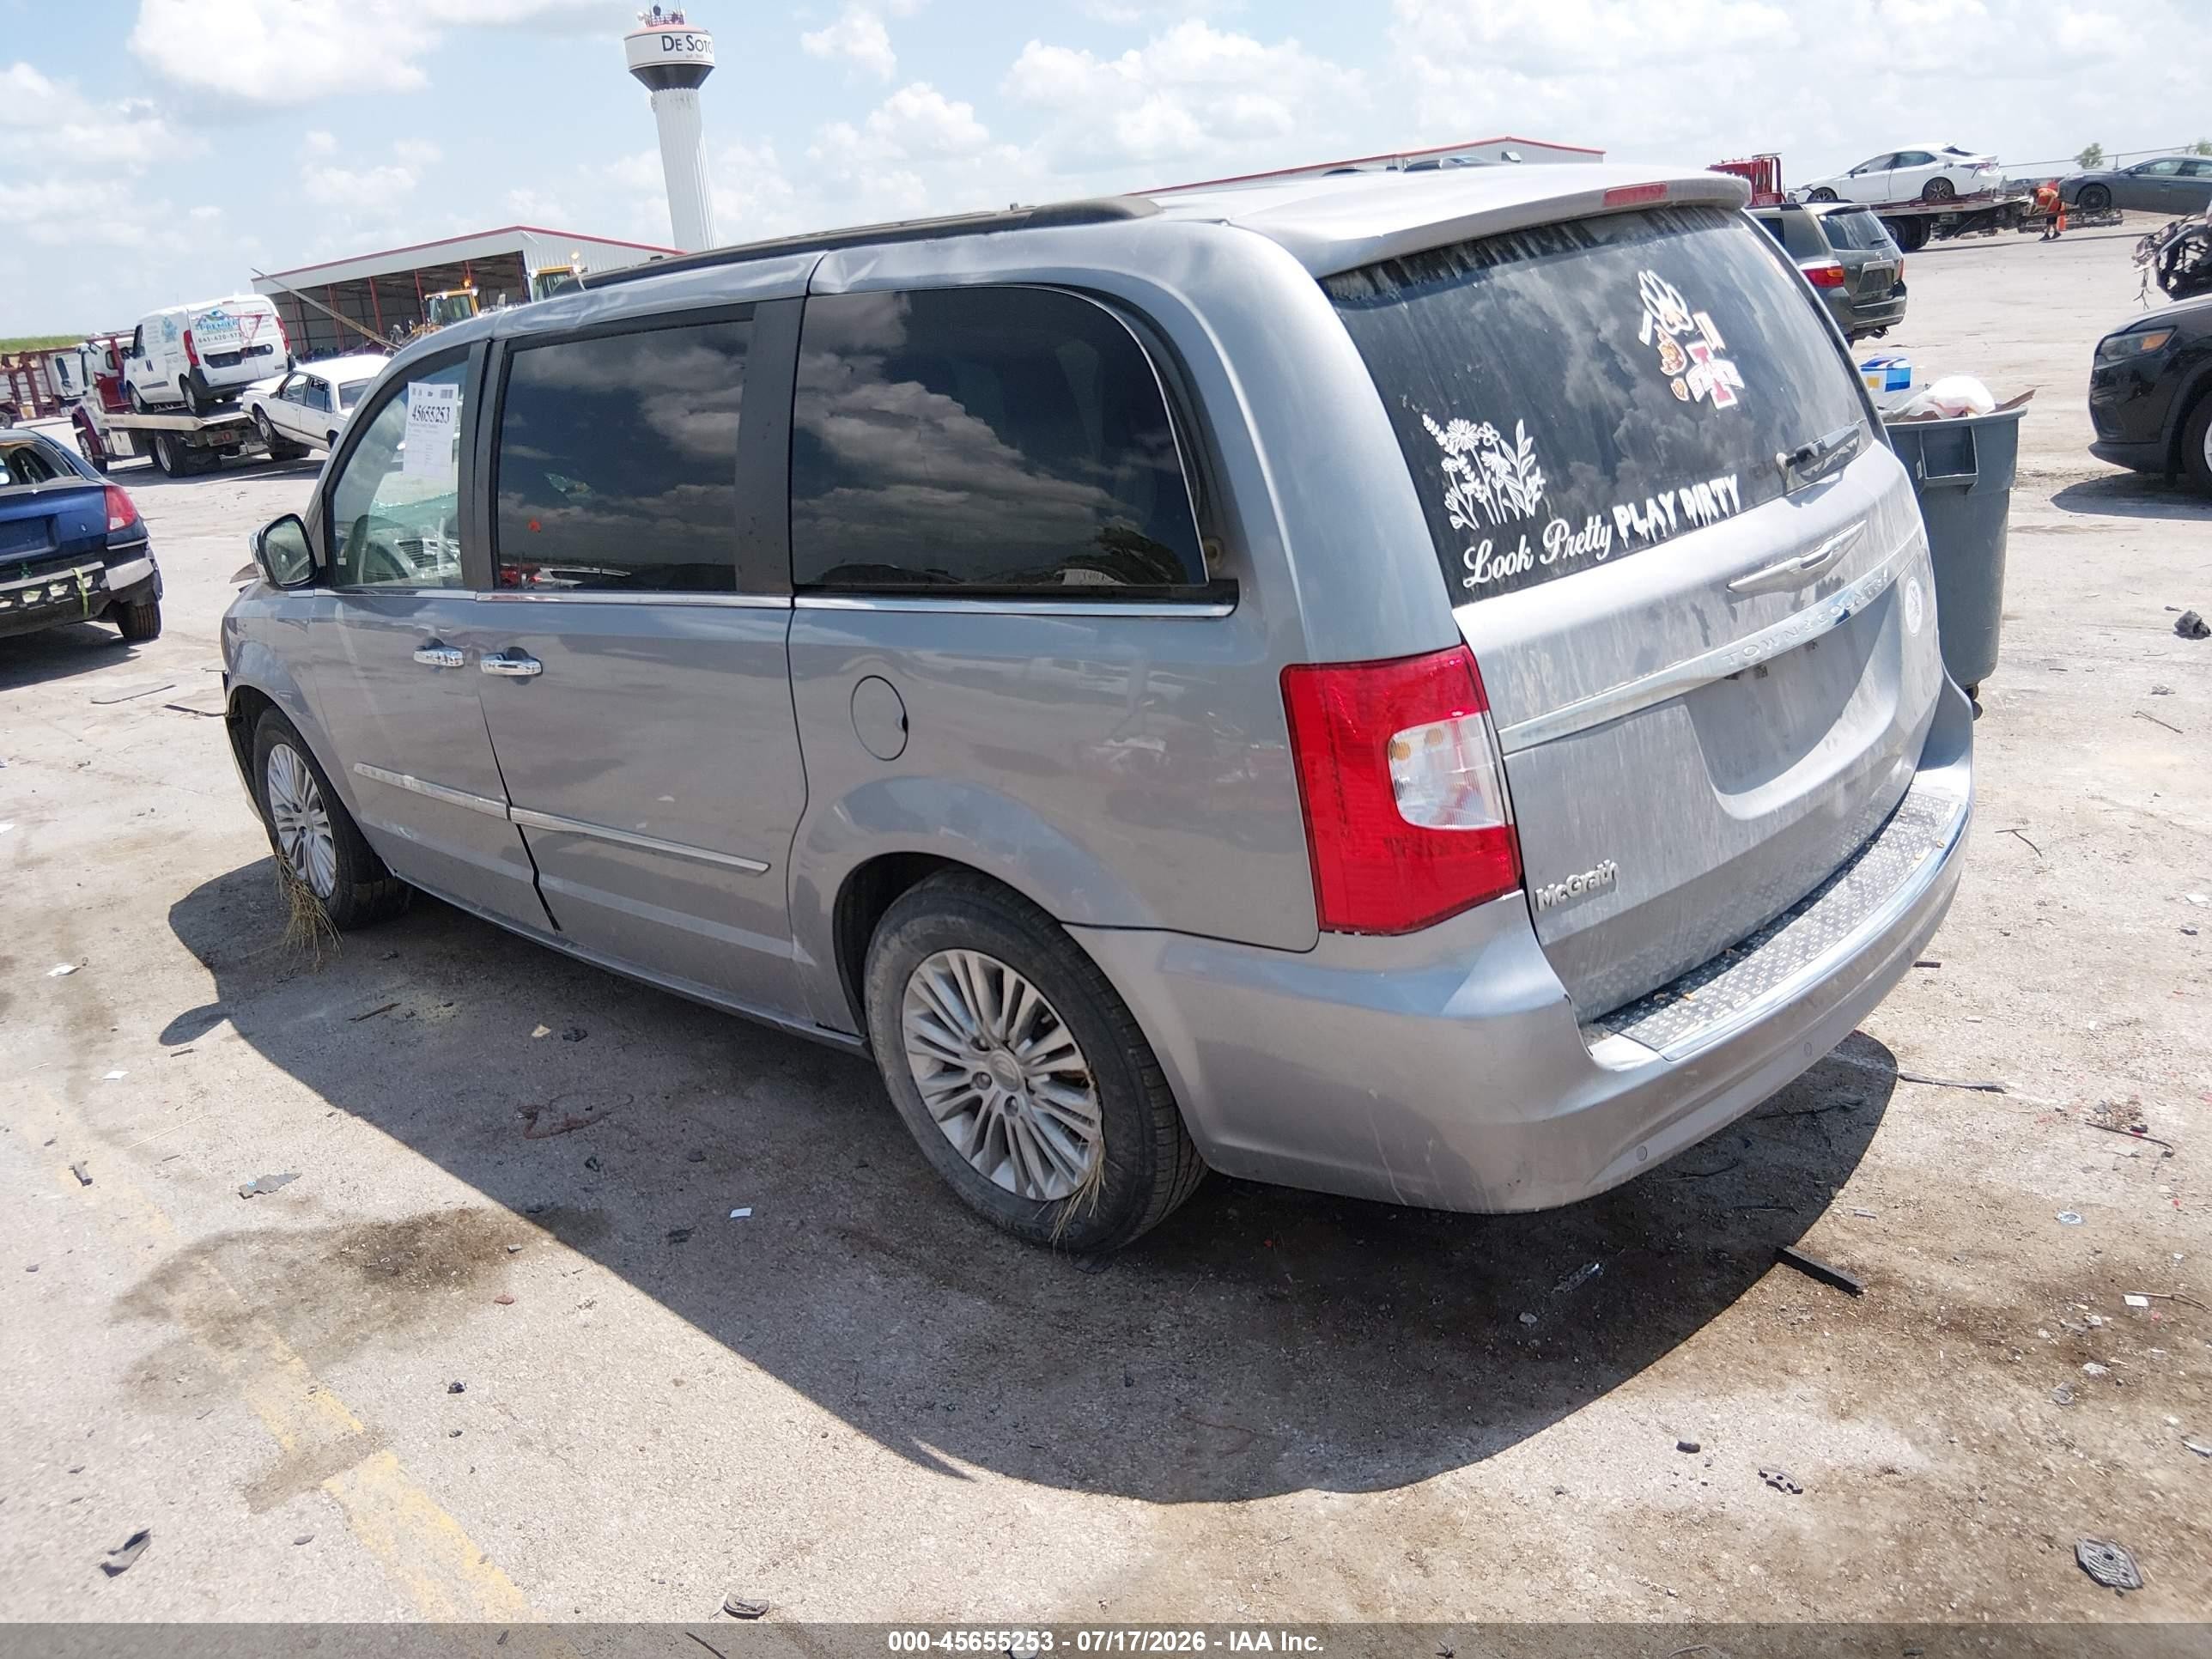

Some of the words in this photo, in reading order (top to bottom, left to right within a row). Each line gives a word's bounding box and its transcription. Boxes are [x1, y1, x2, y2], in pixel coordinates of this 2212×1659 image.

[412, 404, 450, 424] 45655253
[1462, 534, 1534, 588] Look
[1540, 515, 1612, 564] Pretty
[1613, 491, 1677, 549] PLAY
[1679, 474, 1741, 527] DIRTY
[1728, 626, 1800, 665] TOWN
[1534, 859, 1620, 912] McGrath
